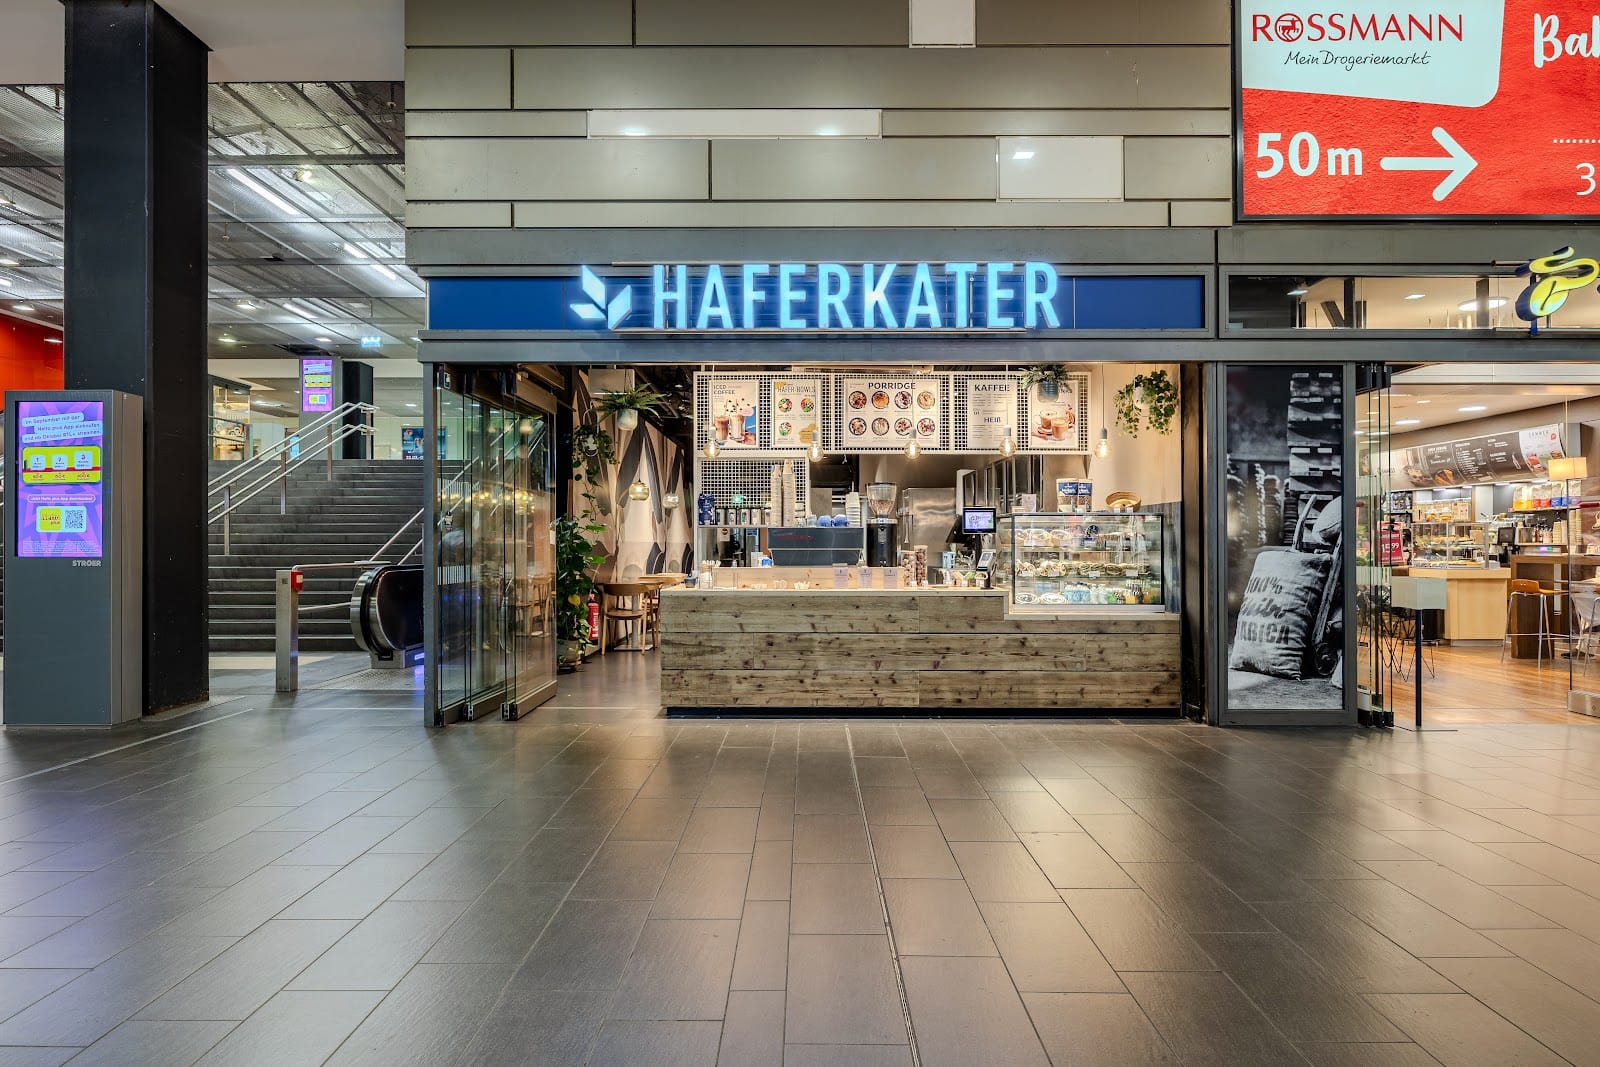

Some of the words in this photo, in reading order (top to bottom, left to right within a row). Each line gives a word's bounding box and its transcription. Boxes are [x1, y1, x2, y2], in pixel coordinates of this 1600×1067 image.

[1252, 13, 1463, 42] ROSSMANN
[1284, 51, 1319, 65] Mein
[1320, 50, 1431, 72] Drogeriemarkt
[1255, 131, 1320, 179] 50
[1326, 145, 1363, 176] m
[652, 262, 1060, 329] HAFERKATER
[868, 382, 916, 390] PORRIDGE
[974, 384, 1010, 392] KAFFEE
